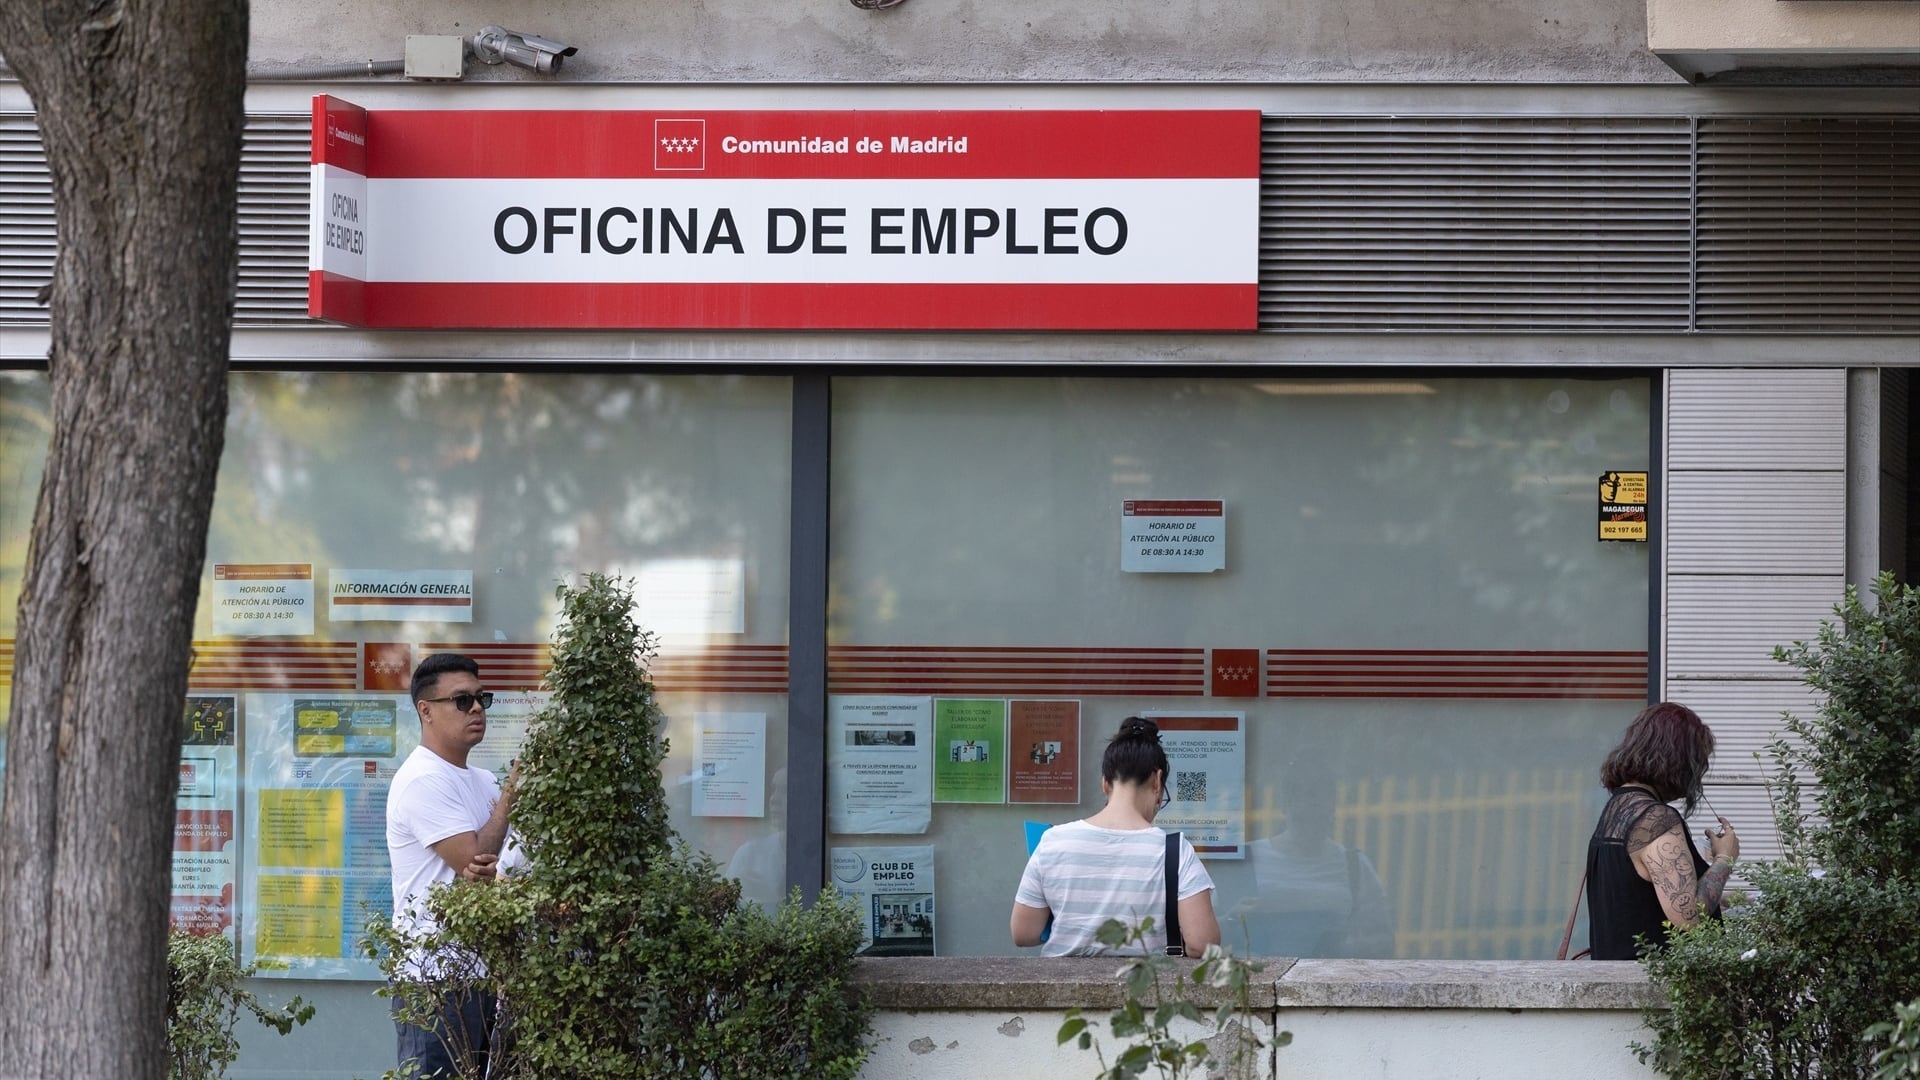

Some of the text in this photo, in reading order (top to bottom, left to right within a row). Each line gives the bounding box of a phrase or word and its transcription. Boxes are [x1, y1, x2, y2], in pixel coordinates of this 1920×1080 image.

[721, 135, 969, 155] Comunidad de Madrid
[332, 193, 359, 223] OFICINA
[492, 207, 1129, 256] OFICINA DE EMPLEO
[326, 222, 364, 256] DE EMPLEO
[1130, 534, 1215, 543] ATENCIÓN AL PÚBLICO
[334, 581, 471, 595] INFORMACIÓN GENERAL
[222, 597, 259, 606] ATENCIÓN
[272, 597, 304, 606] PÚBLICO
[243, 612, 264, 620] 08:30
[265, 612, 271, 620] A
[273, 612, 294, 620] 14:30
[871, 863, 898, 871] CLUB
[873, 872, 914, 880] EMPLEO
